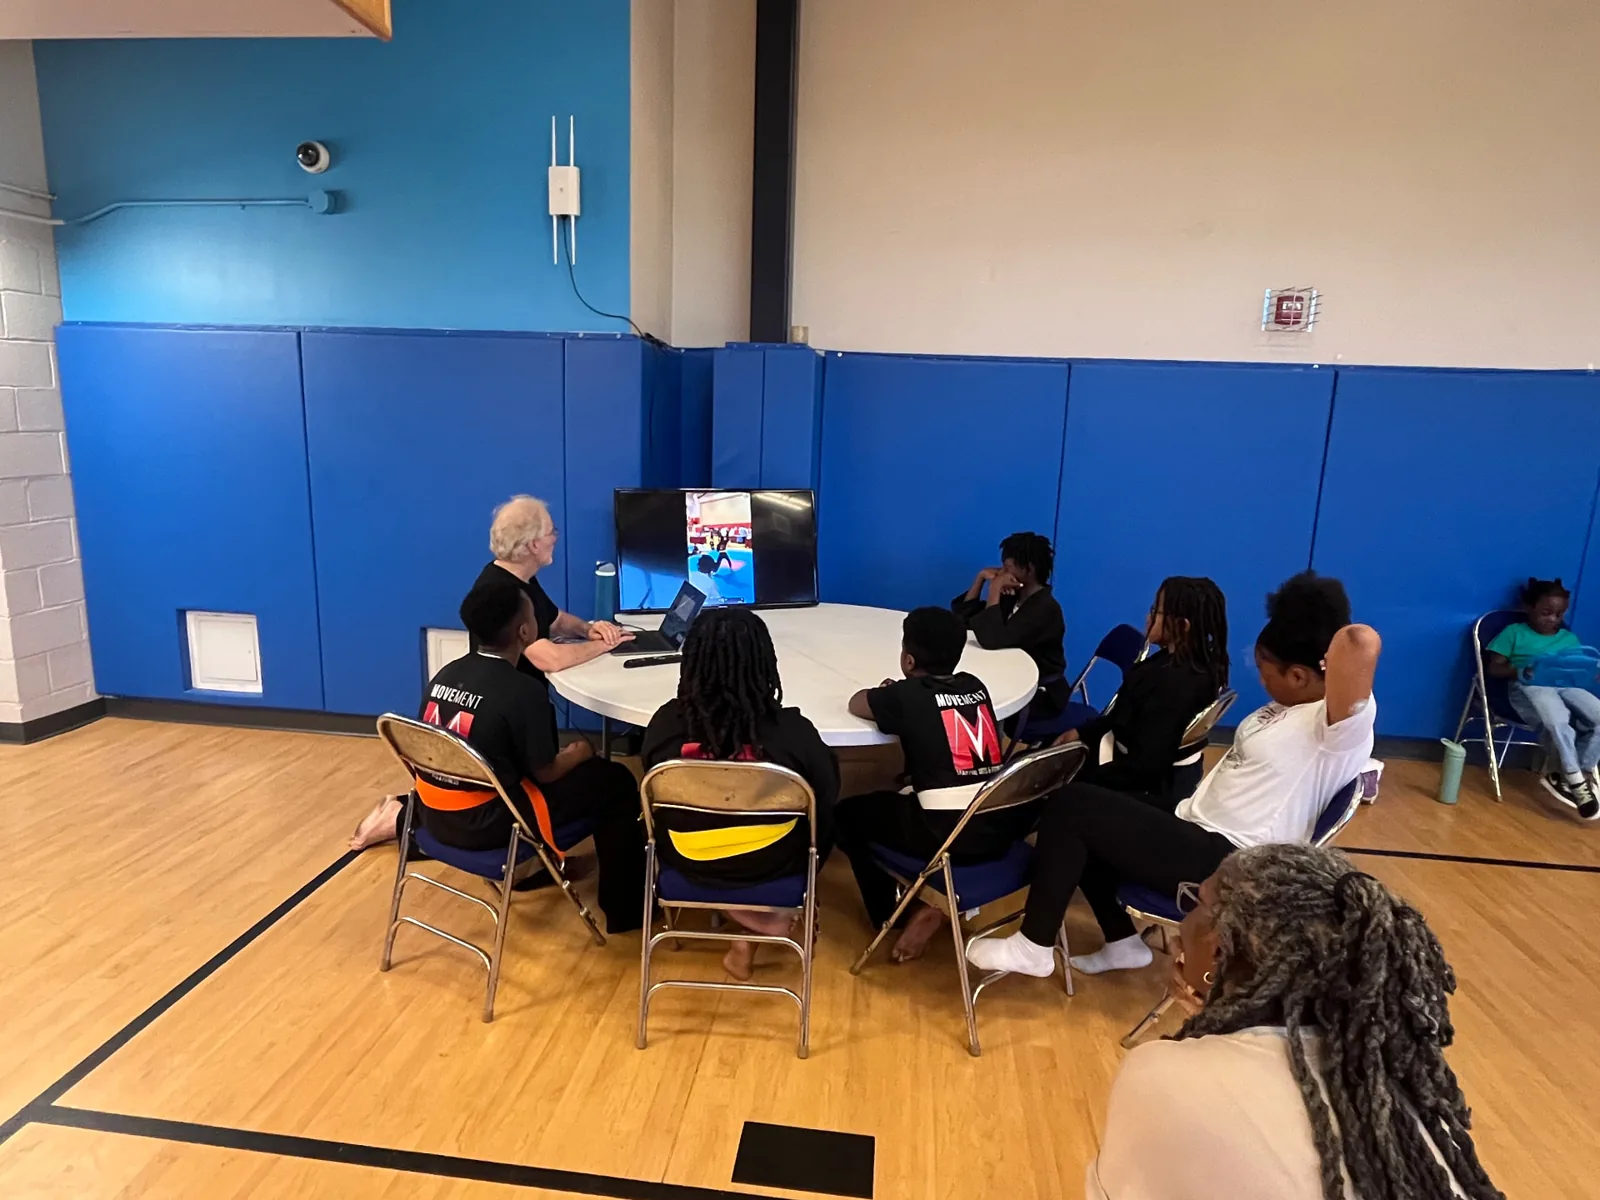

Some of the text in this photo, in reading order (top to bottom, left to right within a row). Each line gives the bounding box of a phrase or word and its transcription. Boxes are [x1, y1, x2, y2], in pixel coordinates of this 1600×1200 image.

[430, 683, 483, 710] MOVEMENT
[934, 689, 987, 708] MOVEMENT
[940, 703, 1002, 770] M
